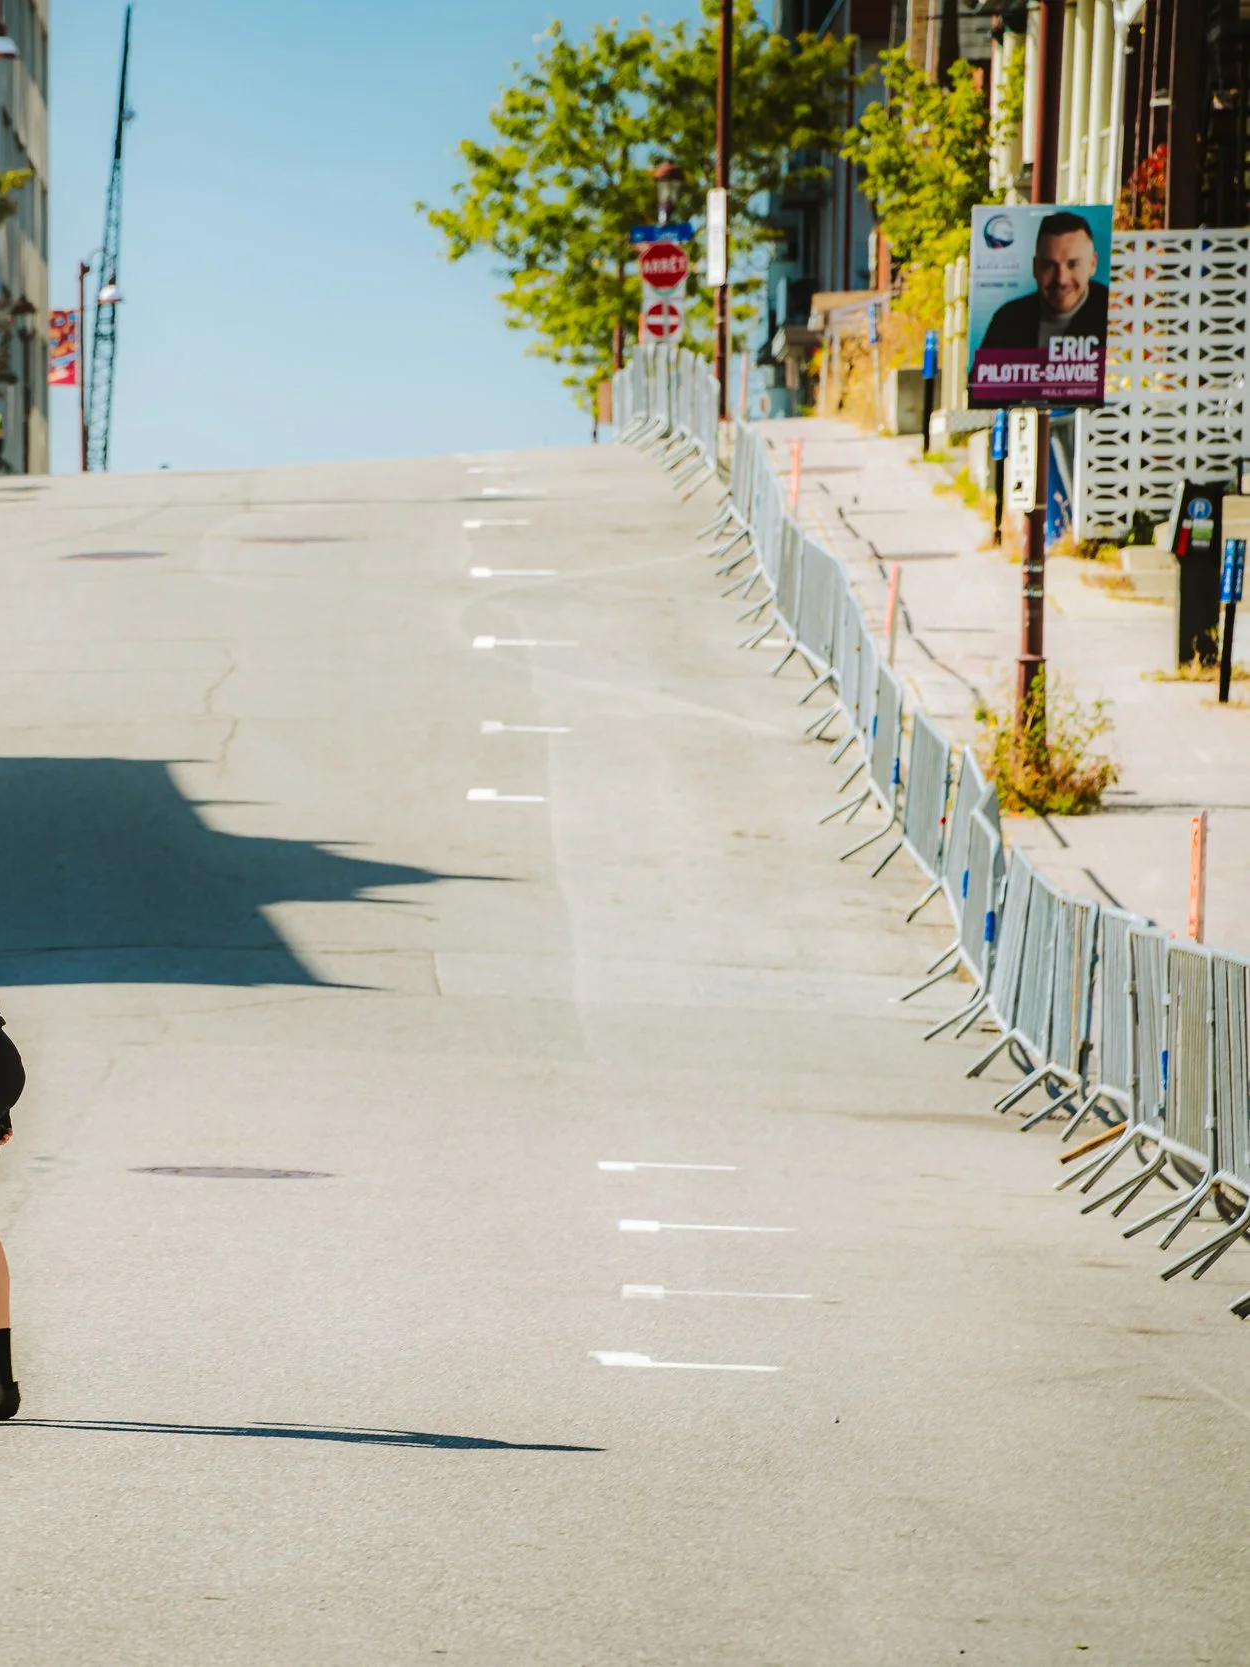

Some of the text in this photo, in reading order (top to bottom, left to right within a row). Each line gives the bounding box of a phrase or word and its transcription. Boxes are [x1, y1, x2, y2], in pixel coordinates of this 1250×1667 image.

[642, 254, 686, 274] ARRÊT
[1049, 336, 1099, 361] ERIC
[977, 364, 1099, 382] PILOTTE-SAVOIE
